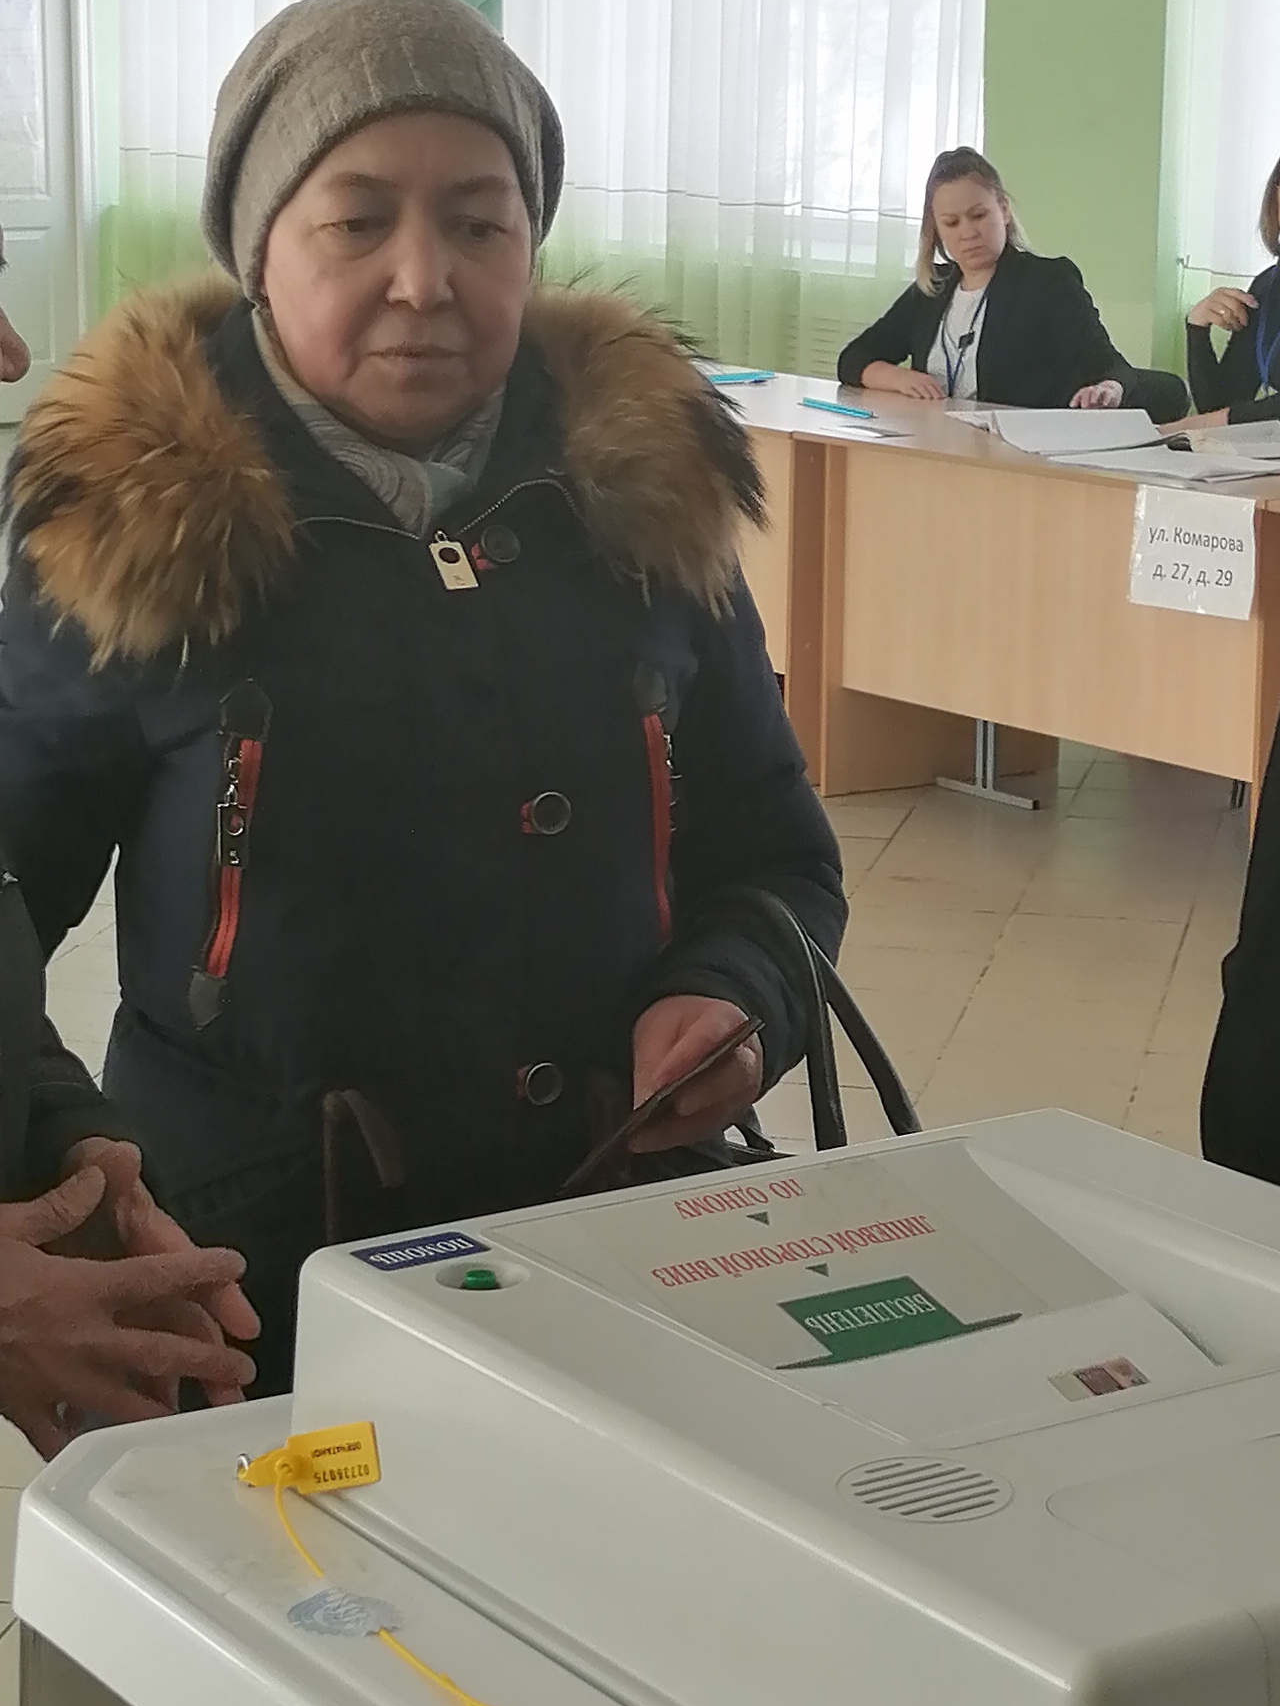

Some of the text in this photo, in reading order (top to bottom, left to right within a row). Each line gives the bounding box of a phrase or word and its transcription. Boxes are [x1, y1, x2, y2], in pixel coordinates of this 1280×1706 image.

[1148, 526, 1245, 553] ул. Комарова
[1151, 562, 1234, 588] д. 27, д. 29
[673, 1177, 804, 1220] ПО ОДНОМУ
[368, 1237, 475, 1264] ПОМОЩЬ
[650, 1214, 938, 1288] ЛИЦЕВОЙ СТОРОНОЙ ВНИЗ
[803, 1292, 938, 1336] БЮЛЛЕТЕНЬ
